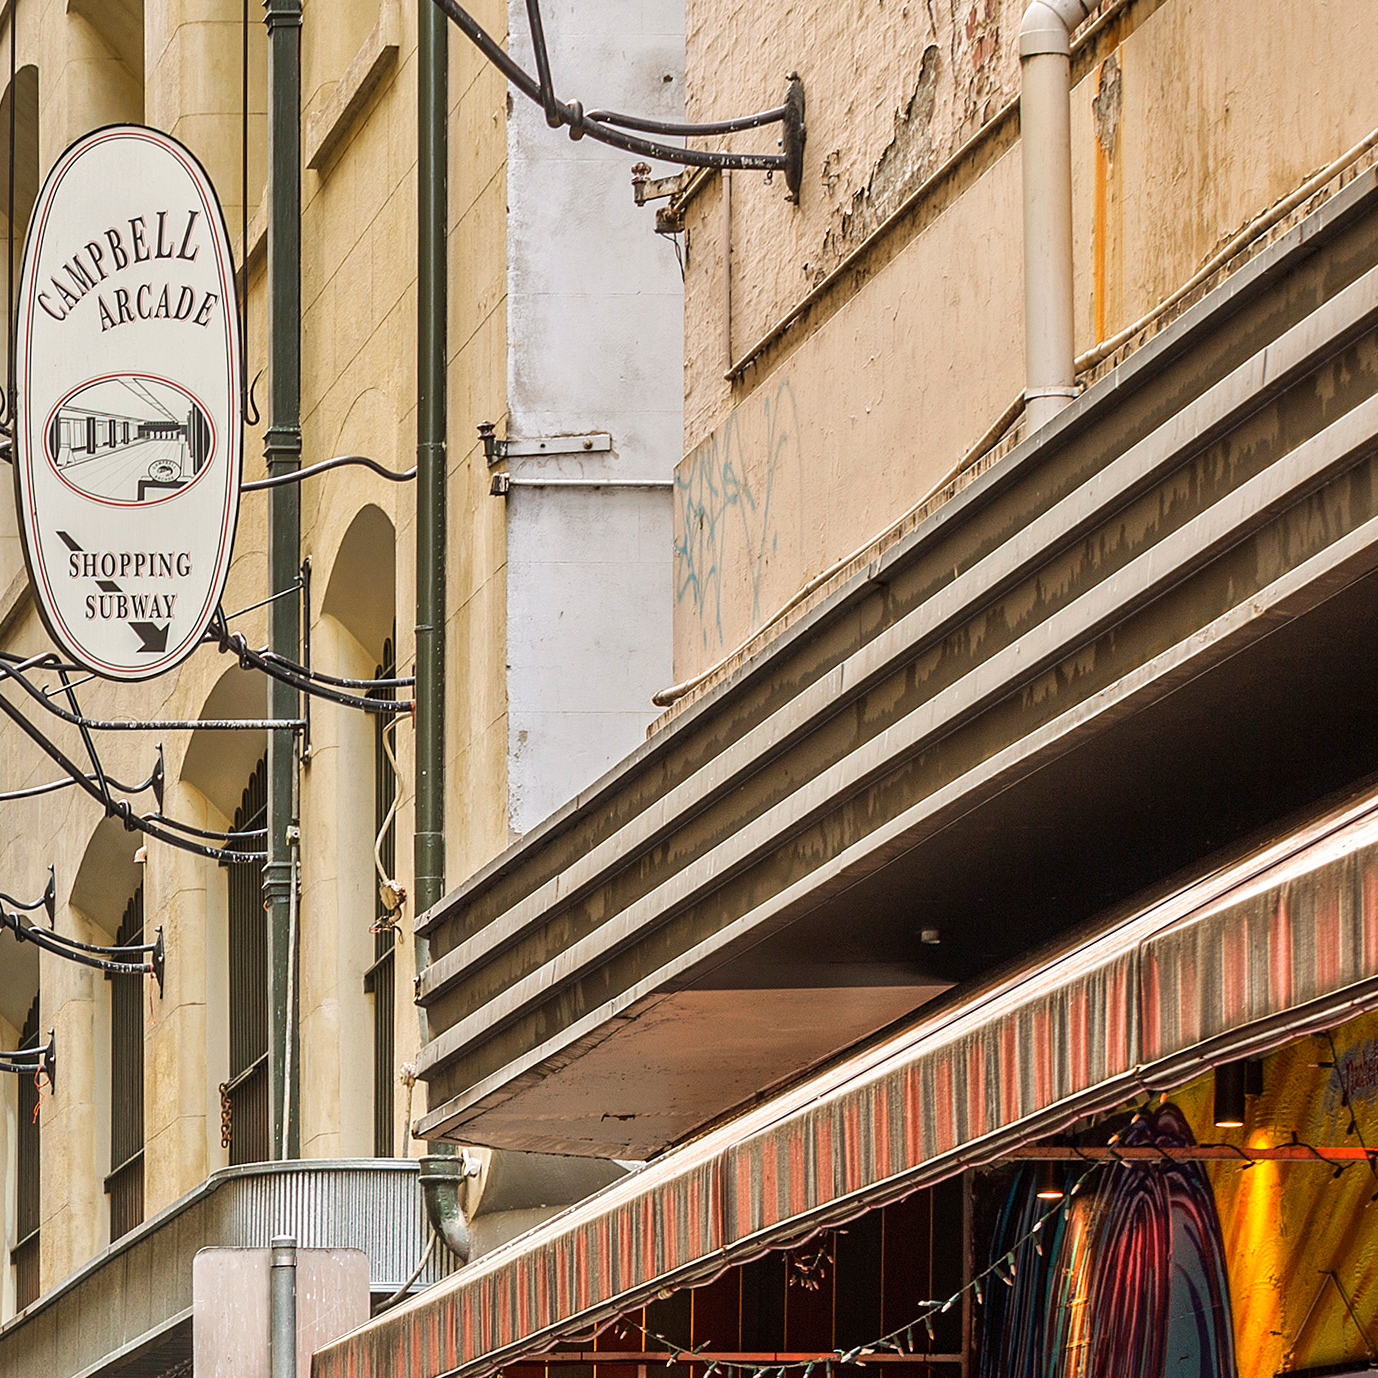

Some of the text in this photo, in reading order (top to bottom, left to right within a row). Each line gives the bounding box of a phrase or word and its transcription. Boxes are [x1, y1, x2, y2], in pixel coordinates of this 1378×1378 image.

[37, 209, 201, 321] CAMPBELL
[97, 282, 220, 333] ARCADE
[68, 550, 193, 579] SHOPPING
[84, 592, 178, 620] SUBWAY
